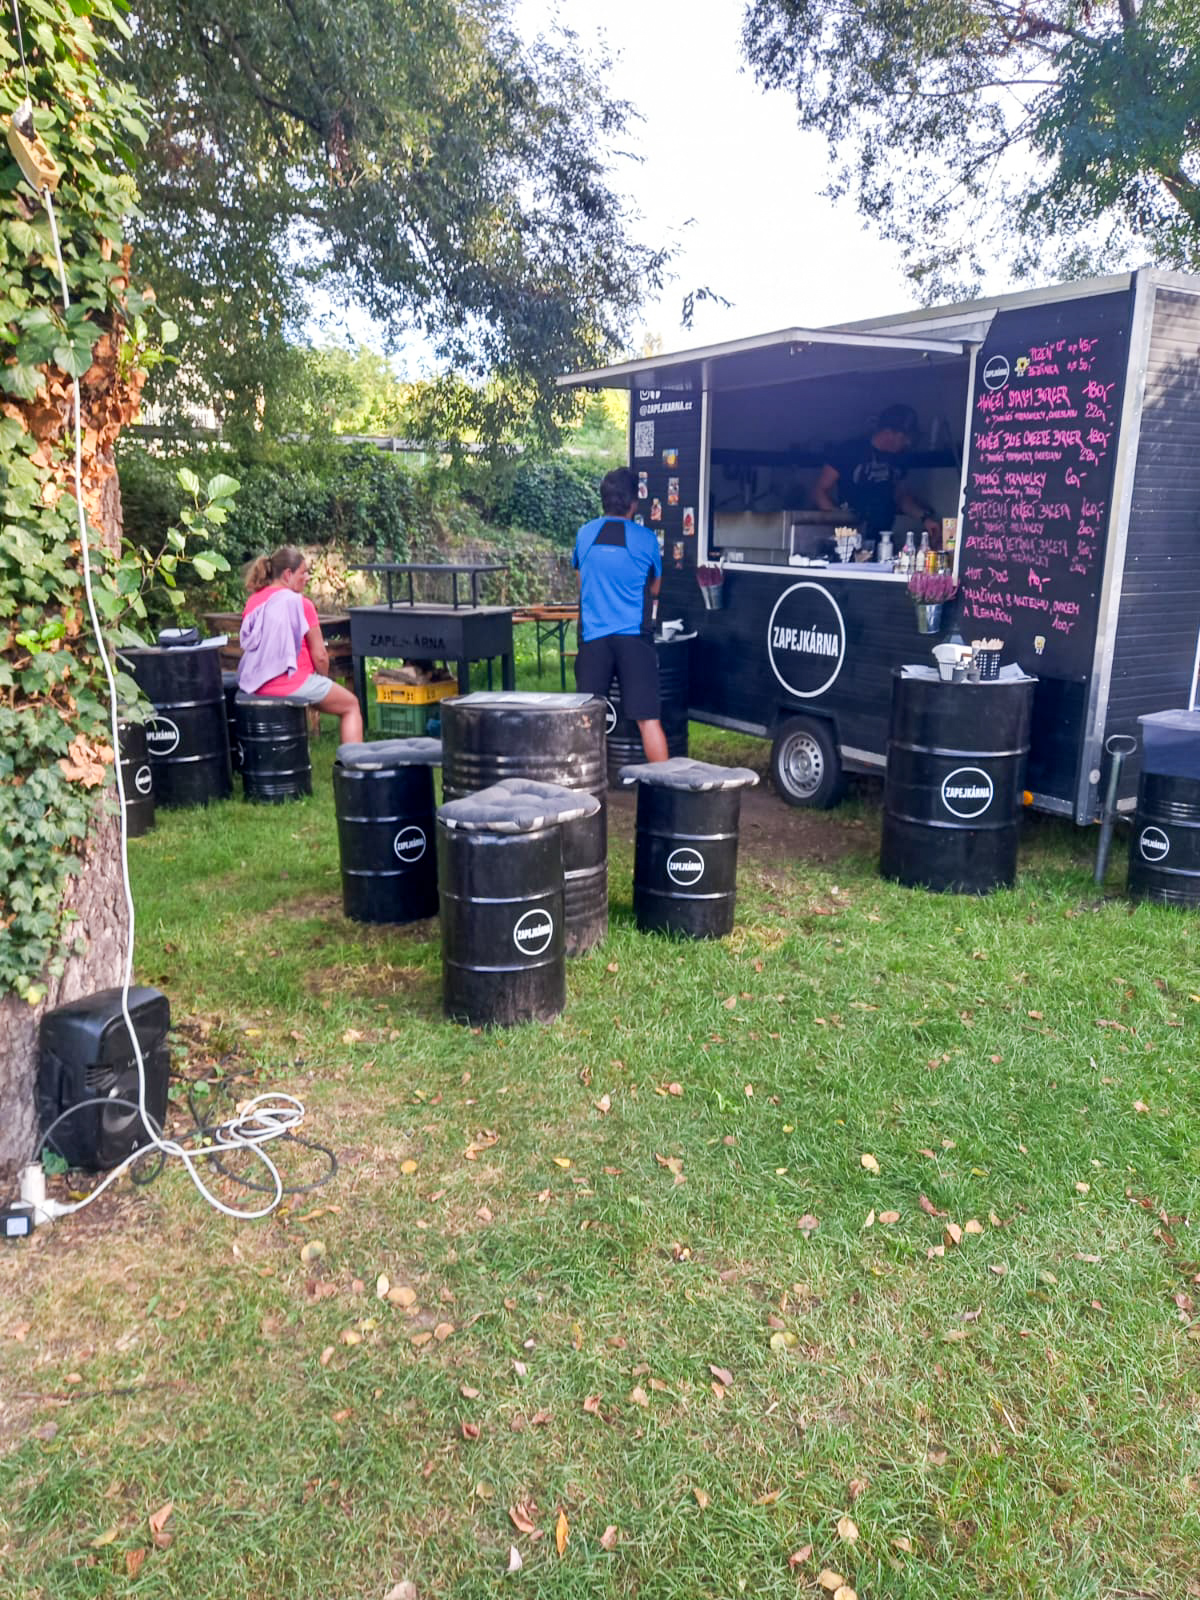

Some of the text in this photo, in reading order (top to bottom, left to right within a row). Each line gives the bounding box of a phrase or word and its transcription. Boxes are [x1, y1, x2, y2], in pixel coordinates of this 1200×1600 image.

[965, 566, 983, 580] HOT
[988, 566, 1009, 587] DOG
[773, 624, 839, 657] ZAPEJKÁRNA
[946, 785, 990, 799] ZAPEJKÁRNA
[669, 860, 702, 872] ZAPEJKÁRNA
